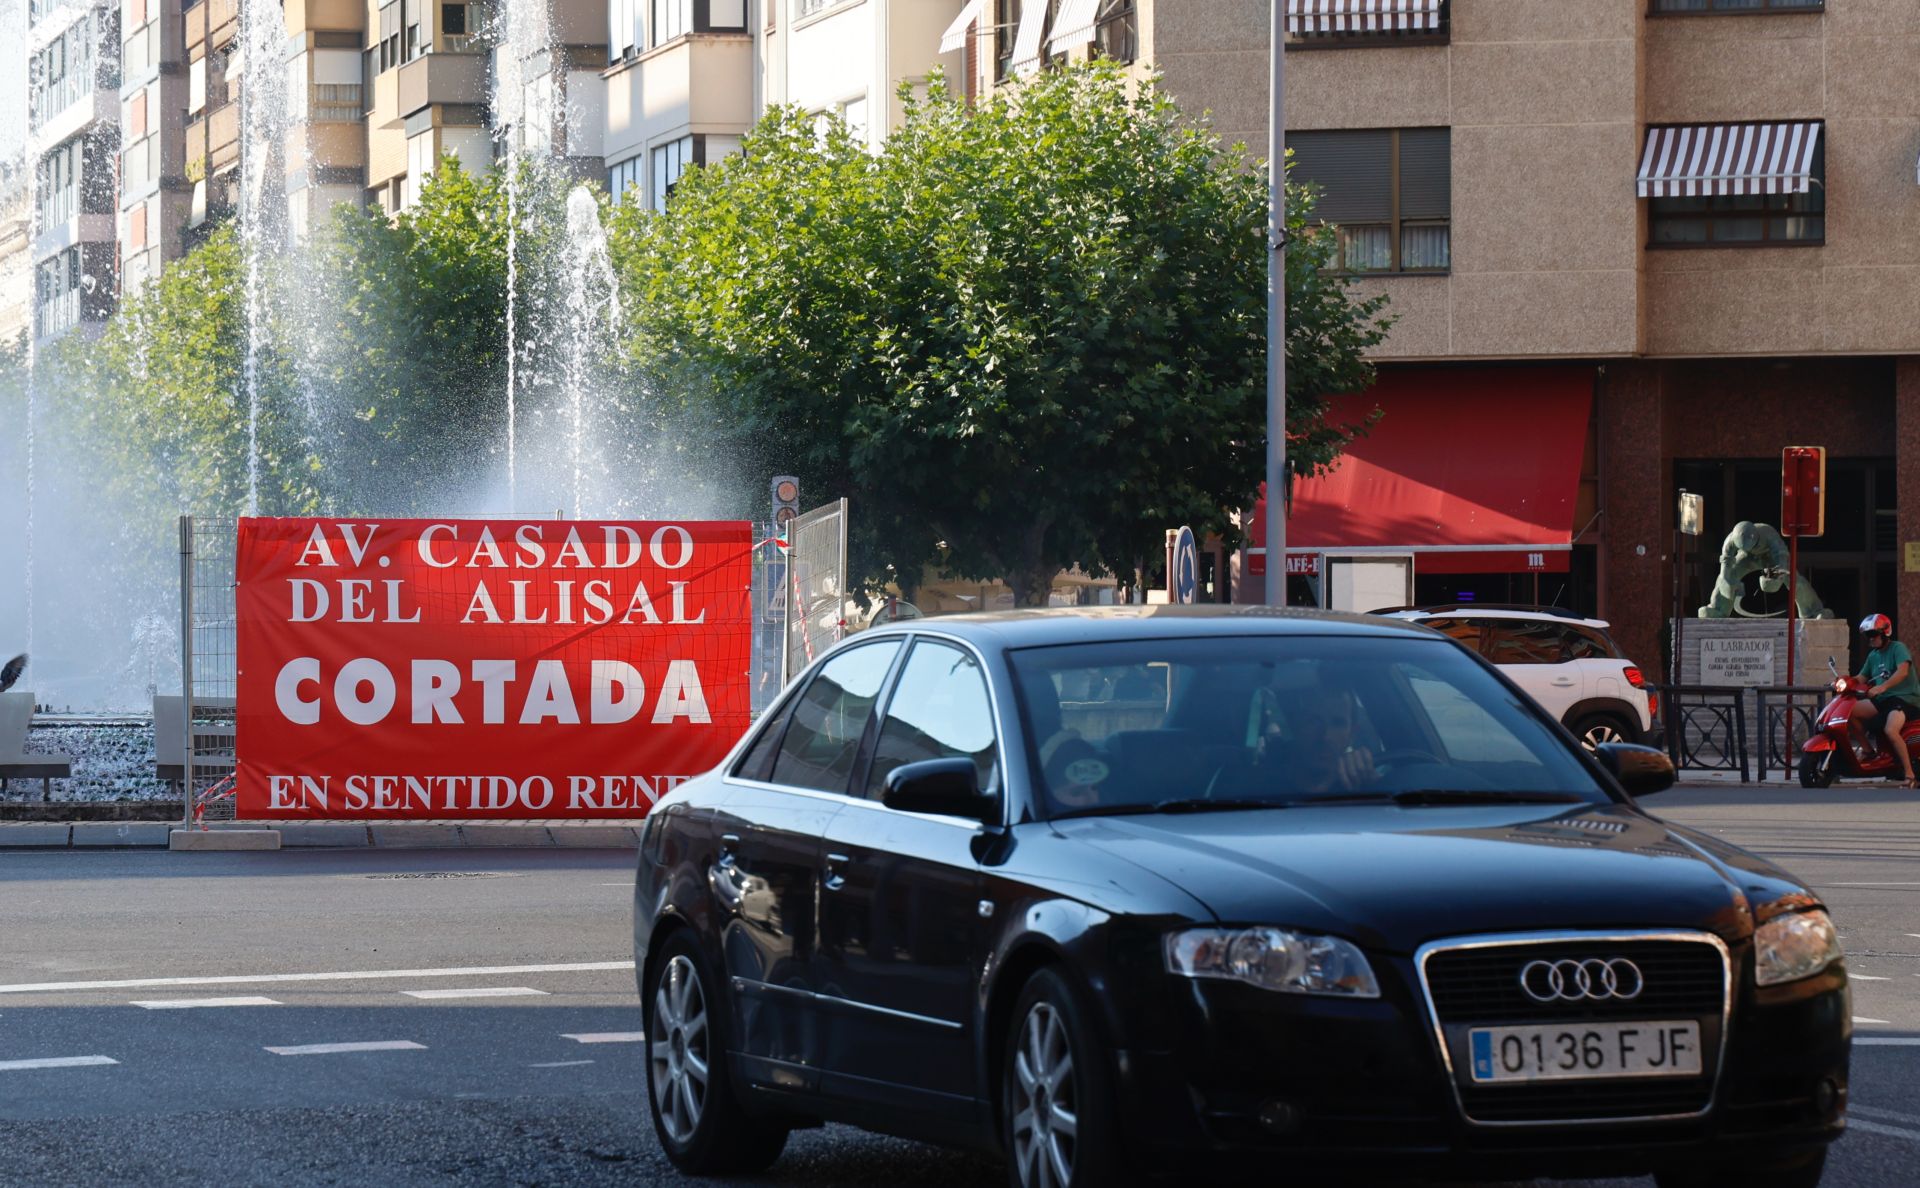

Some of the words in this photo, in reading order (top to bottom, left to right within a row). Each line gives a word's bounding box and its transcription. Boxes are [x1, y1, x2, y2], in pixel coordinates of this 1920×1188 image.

[295, 523, 391, 567] AV.
[417, 524, 695, 569] CASADO
[287, 579, 421, 623] DEL
[460, 579, 705, 625] ALISAL
[1703, 641, 1715, 652] AL
[1721, 640, 1771, 652] LABRADOR
[274, 657, 713, 725] CORTADA
[266, 775, 331, 810] EN
[345, 774, 554, 811] SENTIDO
[565, 775, 697, 810] REN
[1501, 1032, 1604, 1073] 0136
[1618, 1028, 1689, 1069] FJF
